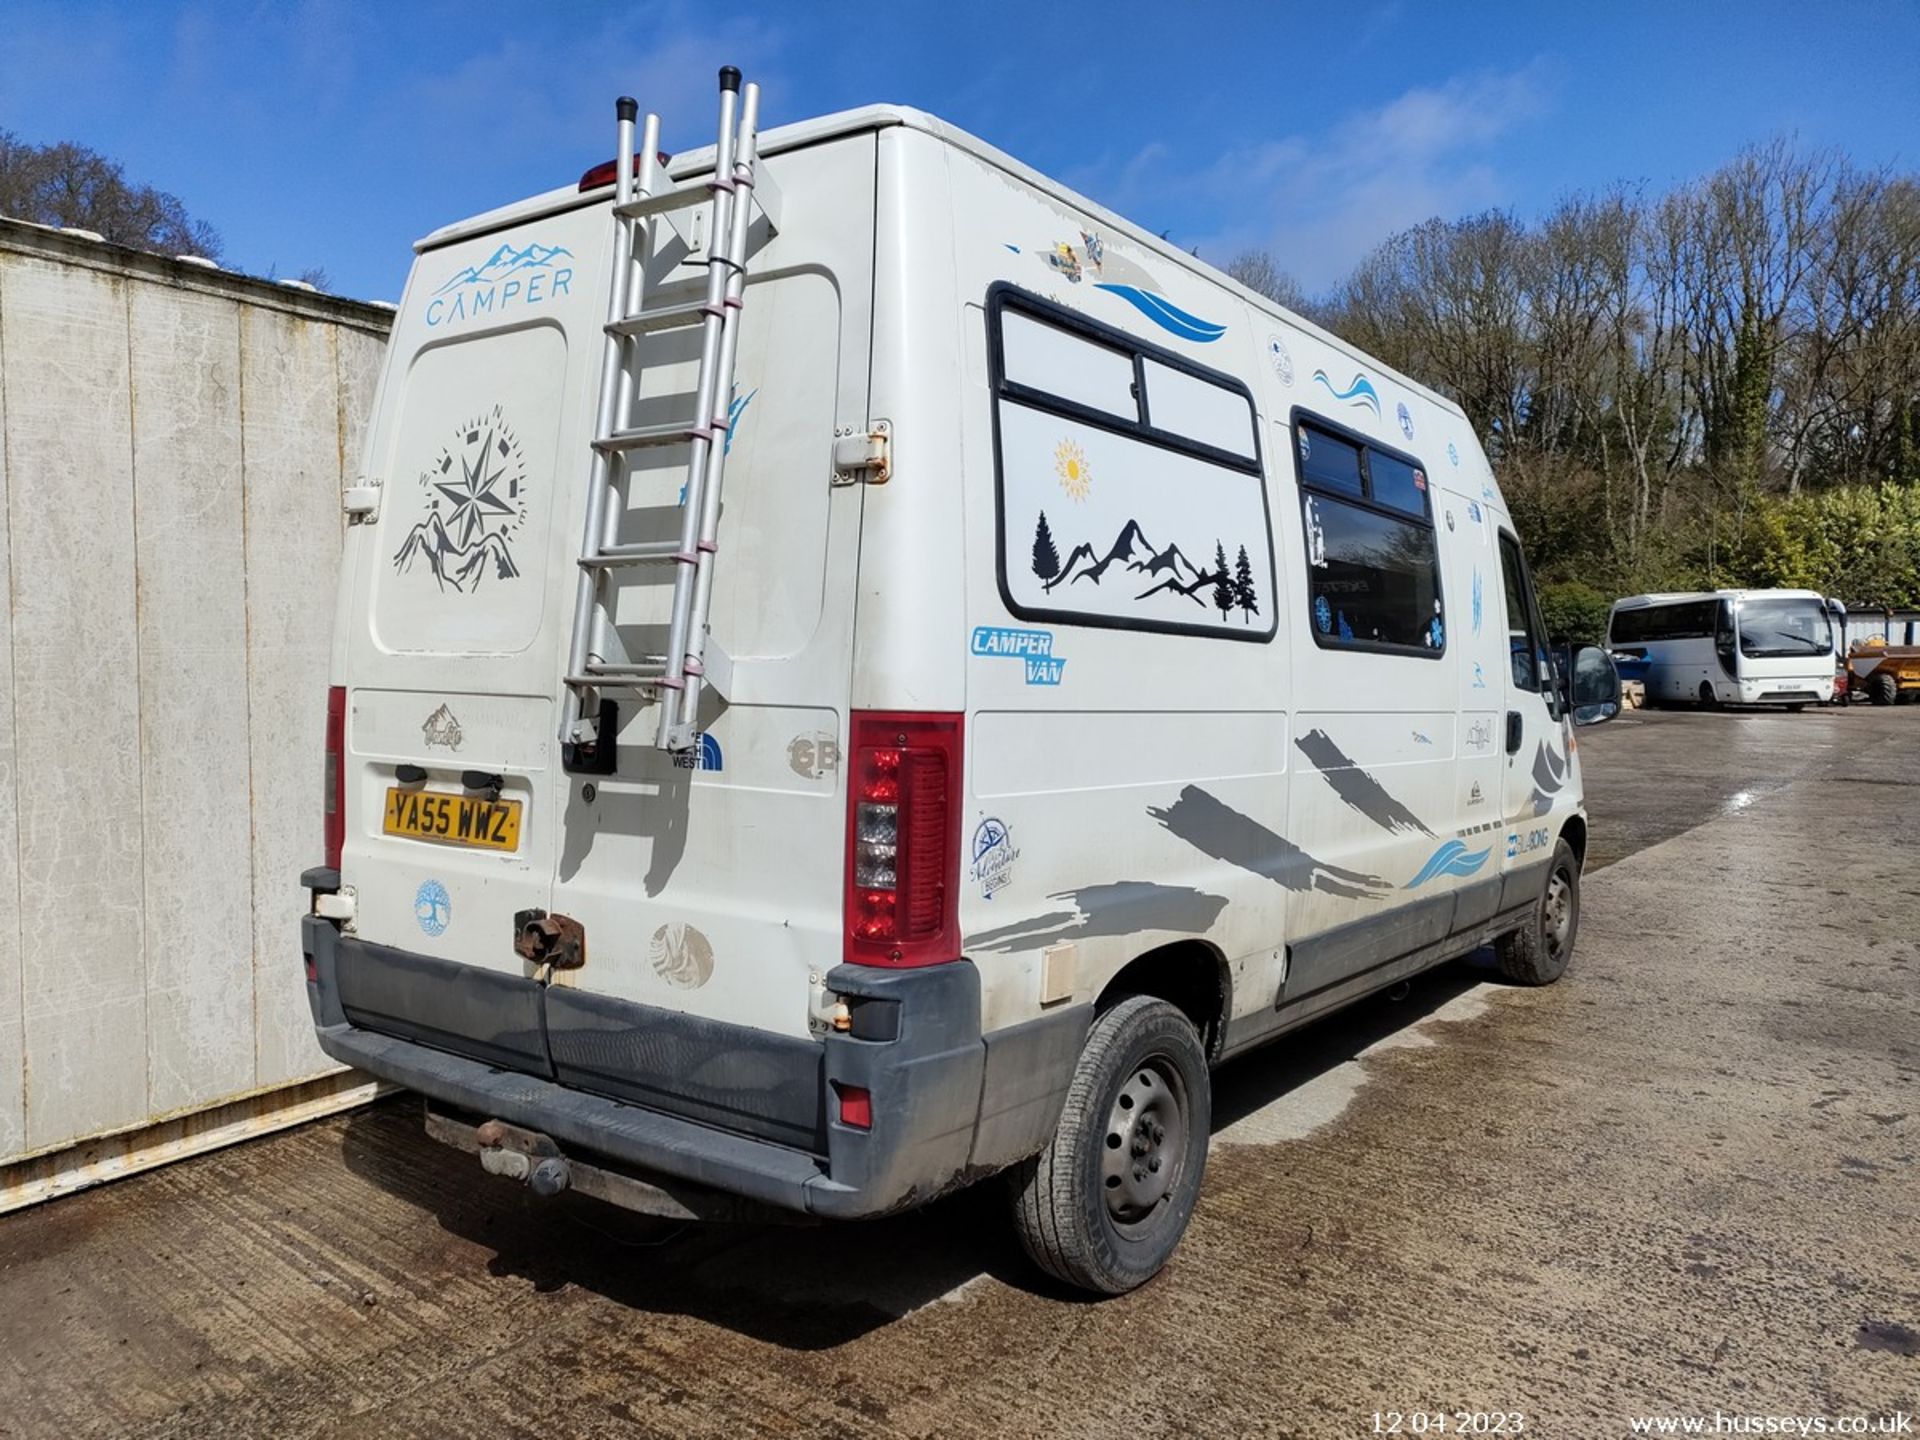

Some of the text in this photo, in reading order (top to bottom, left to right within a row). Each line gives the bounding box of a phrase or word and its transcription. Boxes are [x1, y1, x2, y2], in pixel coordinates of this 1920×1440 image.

[426, 267, 573, 326] CAMPER
[492, 403, 503, 419] N
[973, 630, 1051, 656] CAMPER
[1026, 660, 1062, 682] VAN
[673, 756, 702, 769] WEST
[395, 793, 510, 844] YA55 WWZ
